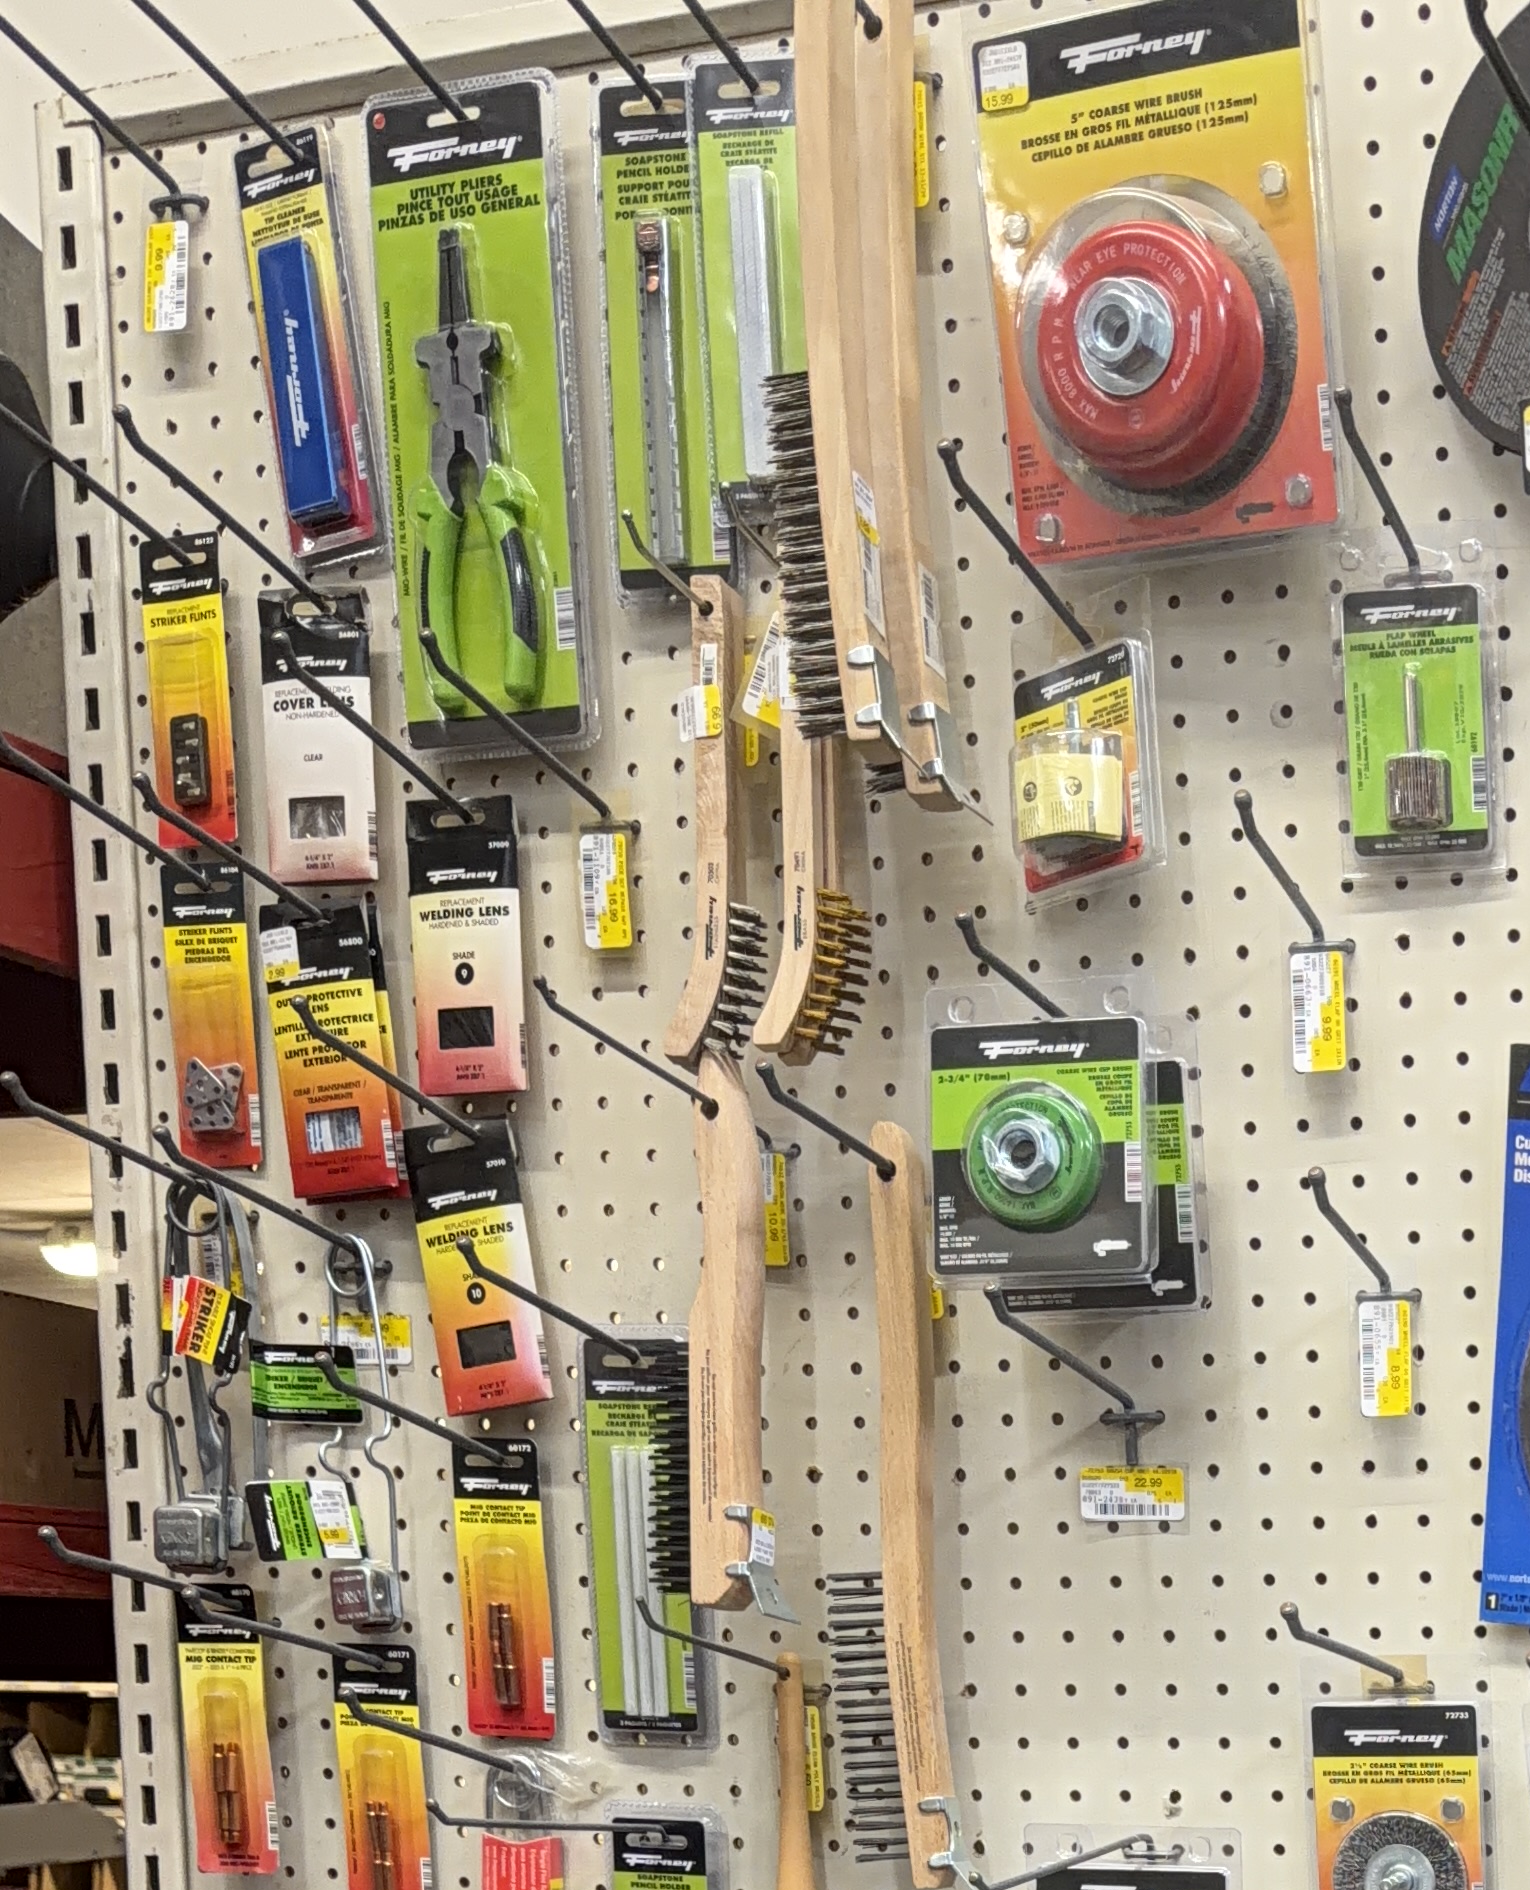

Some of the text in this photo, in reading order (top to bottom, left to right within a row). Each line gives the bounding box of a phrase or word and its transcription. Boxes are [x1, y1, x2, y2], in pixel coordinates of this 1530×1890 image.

[985, 93, 1014, 108] 15.99
[1020, 93, 1258, 150] BROSSE EN GROS FIL MÉTALLIQUE (125mm)
[1031, 111, 1249, 163] CEPILLO DE ALAMBRE GRUESO (125mm)
[410, 173, 503, 200] UTILITY PLIERS
[397, 184, 518, 216] PINCE TOUT USAGE
[378, 193, 541, 232] PINZAS DE USO GENERAL
[150, 610, 217, 628] STRIKER FLINTS
[273, 697, 314, 712] COVER
[440, 898, 485, 907] REPLACEMENT
[608, 893, 618, 922] 16.99
[420, 906, 510, 923] WELDING LENS
[452, 951, 475, 960] SHADE
[978, 1039, 1085, 1060] Forney
[483, 1222, 514, 1235] LENS
[1135, 1478, 1162, 1488] 22.99
